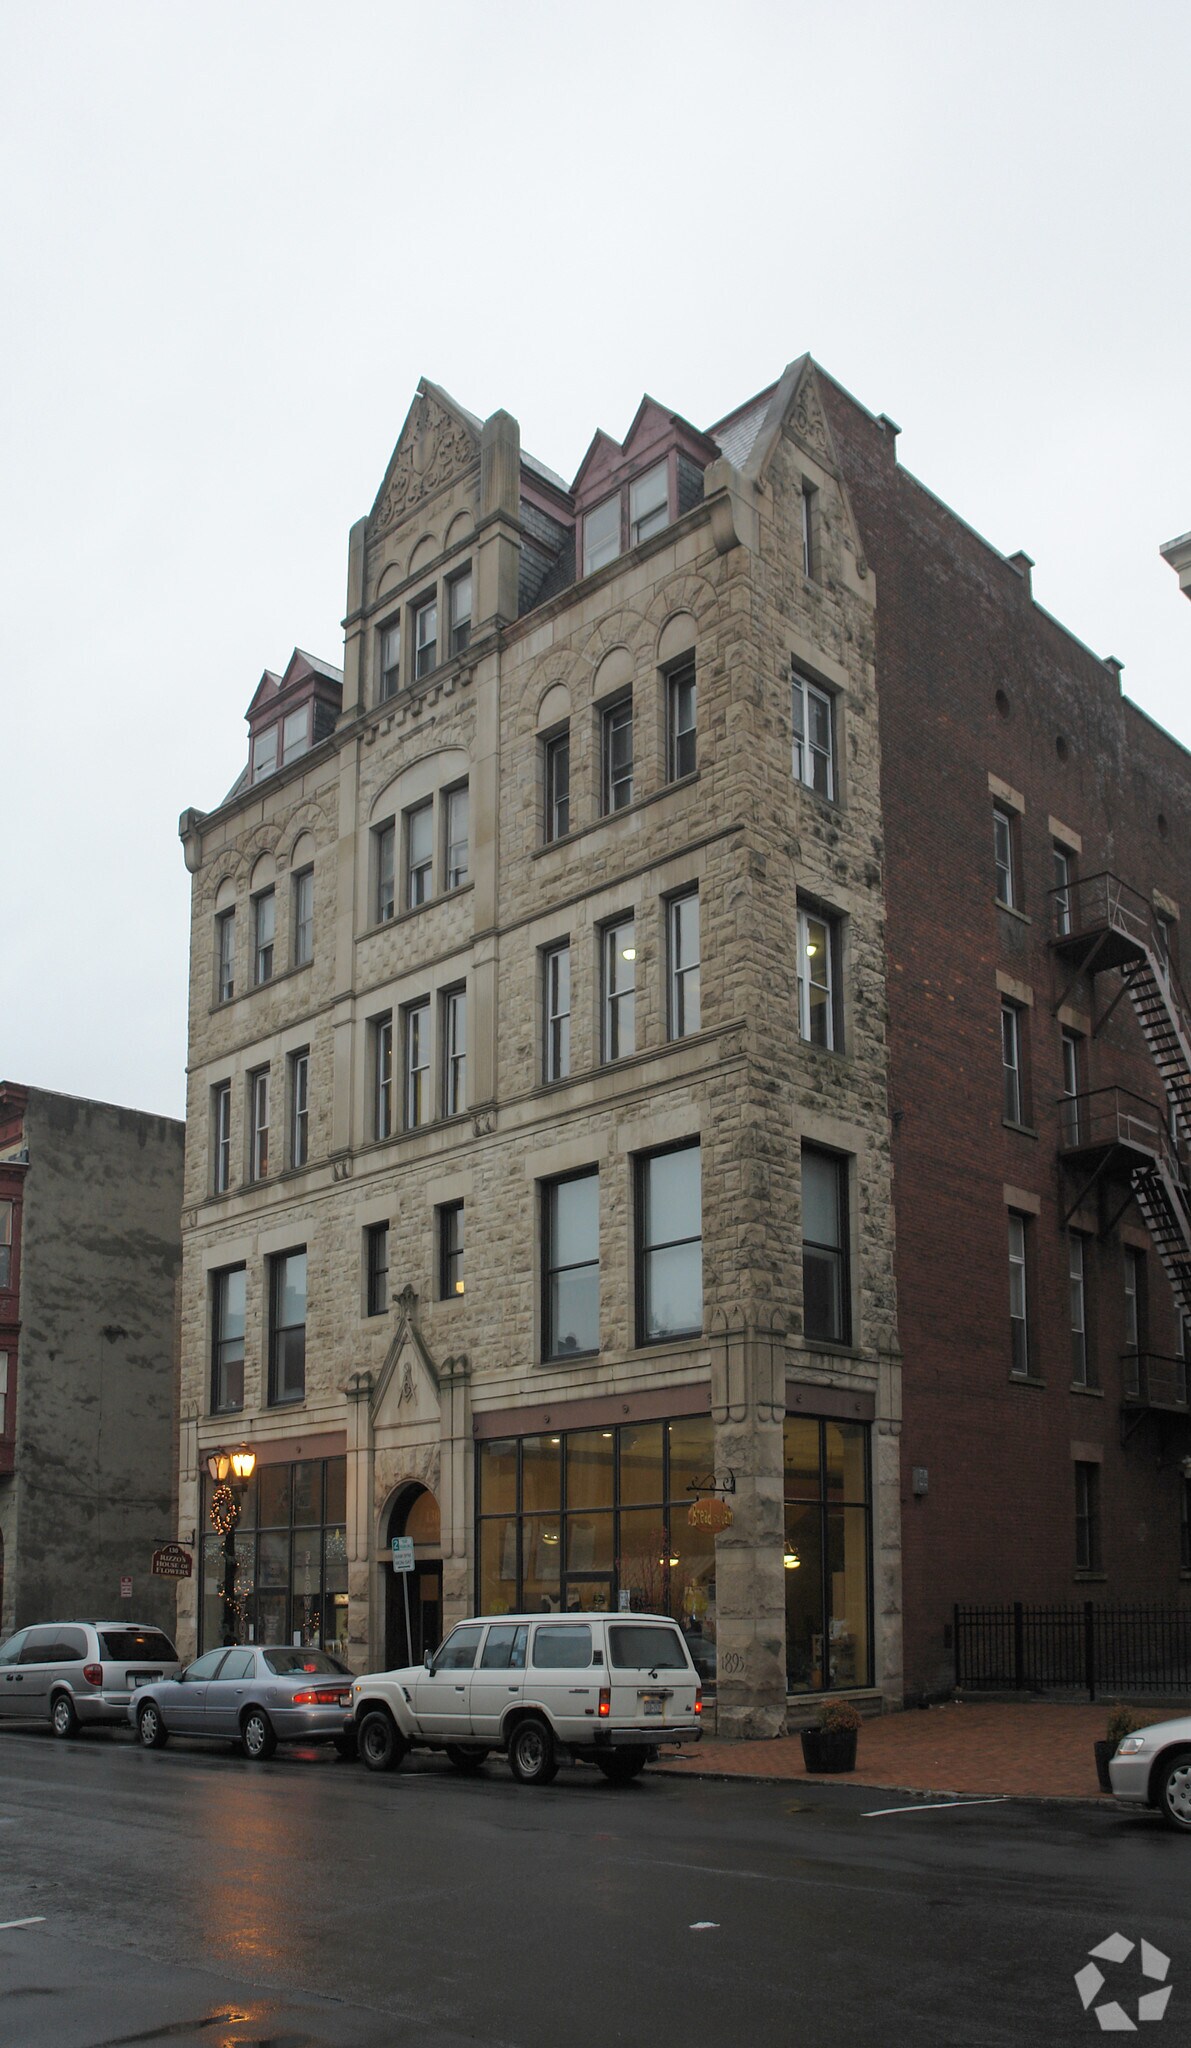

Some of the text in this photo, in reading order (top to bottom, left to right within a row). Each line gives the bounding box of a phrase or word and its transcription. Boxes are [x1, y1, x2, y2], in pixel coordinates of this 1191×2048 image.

[688, 1501, 712, 1526] Bread
[393, 1539, 399, 1550] 2
[160, 1554, 187, 1563] RIZZO'S
[156, 1560, 180, 1569] HOUSE
[156, 1566, 189, 1576] FLOWERS
